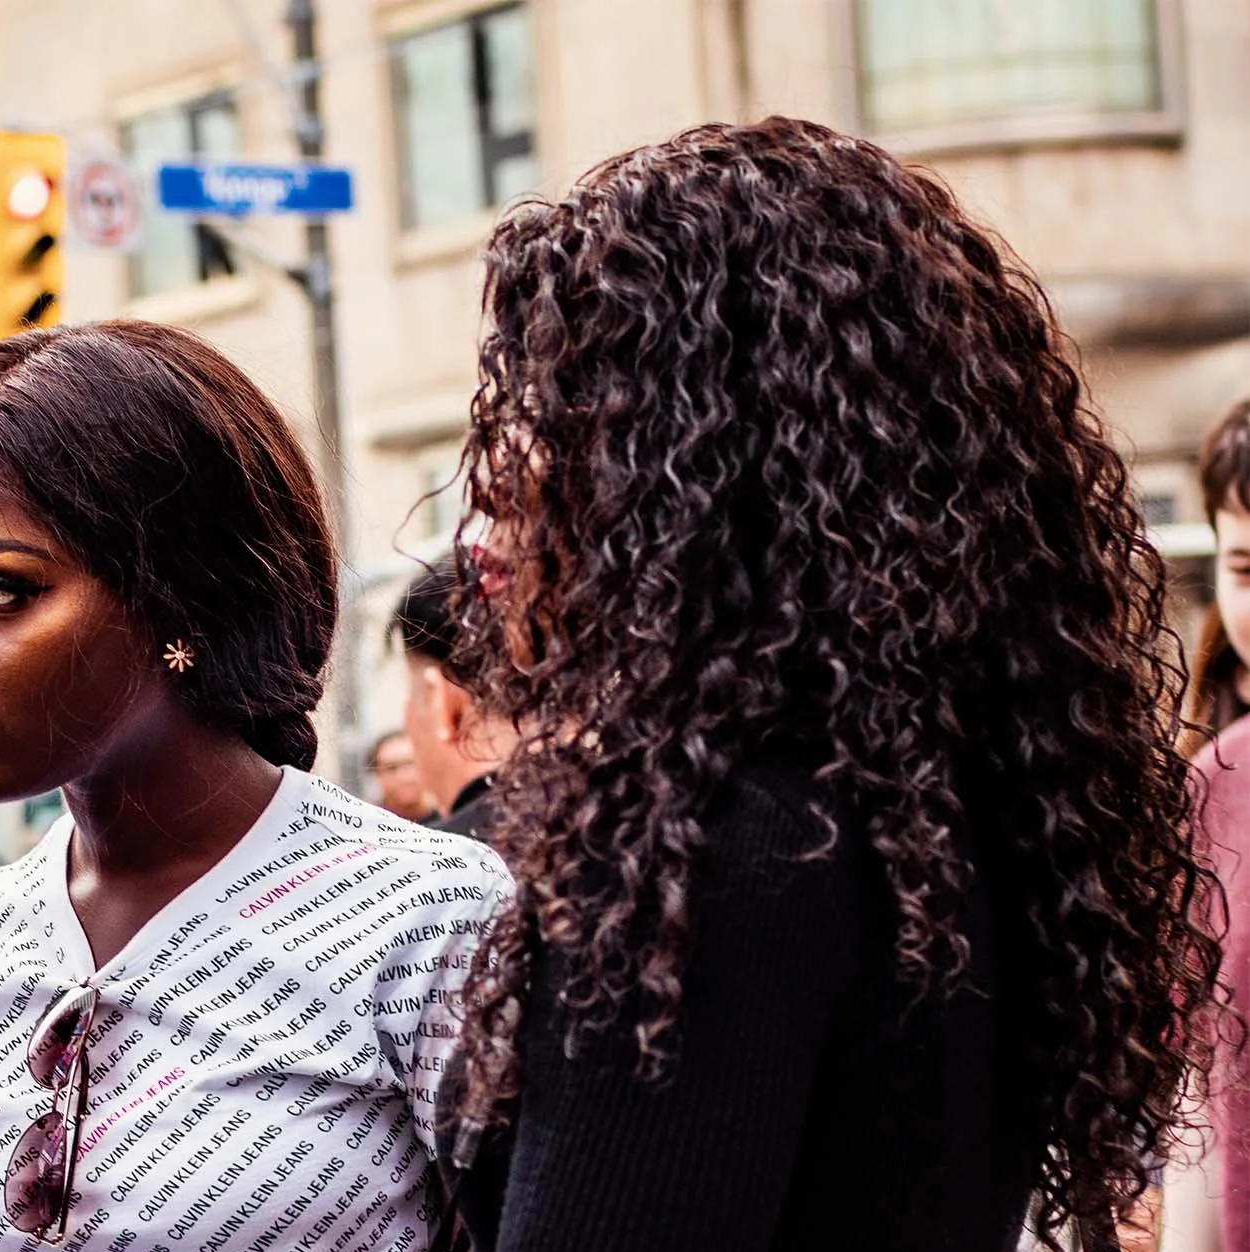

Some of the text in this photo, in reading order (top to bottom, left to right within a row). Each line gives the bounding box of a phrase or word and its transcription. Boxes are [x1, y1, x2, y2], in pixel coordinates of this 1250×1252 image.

[288, 815, 317, 835] JEA
[262, 848, 309, 874] KLEIN
[309, 834, 347, 855] JEAN
[238, 863, 331, 919] CALVIN KLEIN
[261, 857, 399, 936] CALVIN KLEIN JEANS
[282, 871, 421, 952] CALVIN KLEIN JEANS
[437, 885, 484, 904] JEANS
[167, 912, 209, 951] JEANS
[304, 911, 396, 973] CALVIN KLEIN
[404, 923, 446, 945] KLEIN
[169, 966, 213, 998] KLEIN
[210, 938, 253, 974] JEANS
[194, 988, 238, 1015] KLEIN
[234, 956, 275, 996] JEANS
[328, 954, 379, 995] CALVIN
[5, 992, 31, 1024] KLEIN
[82, 1009, 124, 1049] JEANS
[189, 1027, 227, 1066] CALVIN
[260, 977, 301, 1016] JEANS
[286, 997, 327, 1036] JEANS
[312, 1019, 352, 1054] JEANS
[79, 1061, 111, 1091] LEIN
[106, 1029, 144, 1069] JEANS
[84, 1081, 128, 1112] KLEIN
[126, 1048, 163, 1087] JEANS
[339, 1042, 377, 1076] JEANS
[145, 1066, 186, 1098] JEANS
[255, 1072, 289, 1102] CALV
[317, 1092, 360, 1133] CALVIN
[345, 1106, 380, 1150] CALVIN
[85, 1110, 158, 1184] CALVIN KLEIN
[110, 1093, 221, 1203] CALVIN KLEIN JEANS
[138, 1109, 252, 1222] CALVIN KLEIN JEANS
[371, 1124, 401, 1167] CALVIN
[167, 1124, 283, 1241] CALVIN KLEIN JEANS
[235, 1178, 280, 1219] KLEIN
[272, 1140, 315, 1183] JEANS
[269, 1195, 313, 1234] KLEIN
[306, 1156, 345, 1199] JEANS
[73, 1208, 110, 1248] JEANS
[298, 1211, 339, 1250] KLEIN
[334, 1173, 370, 1216] JEANS
[354, 1190, 389, 1231] JEANS
[368, 1206, 397, 1248] JEANS
